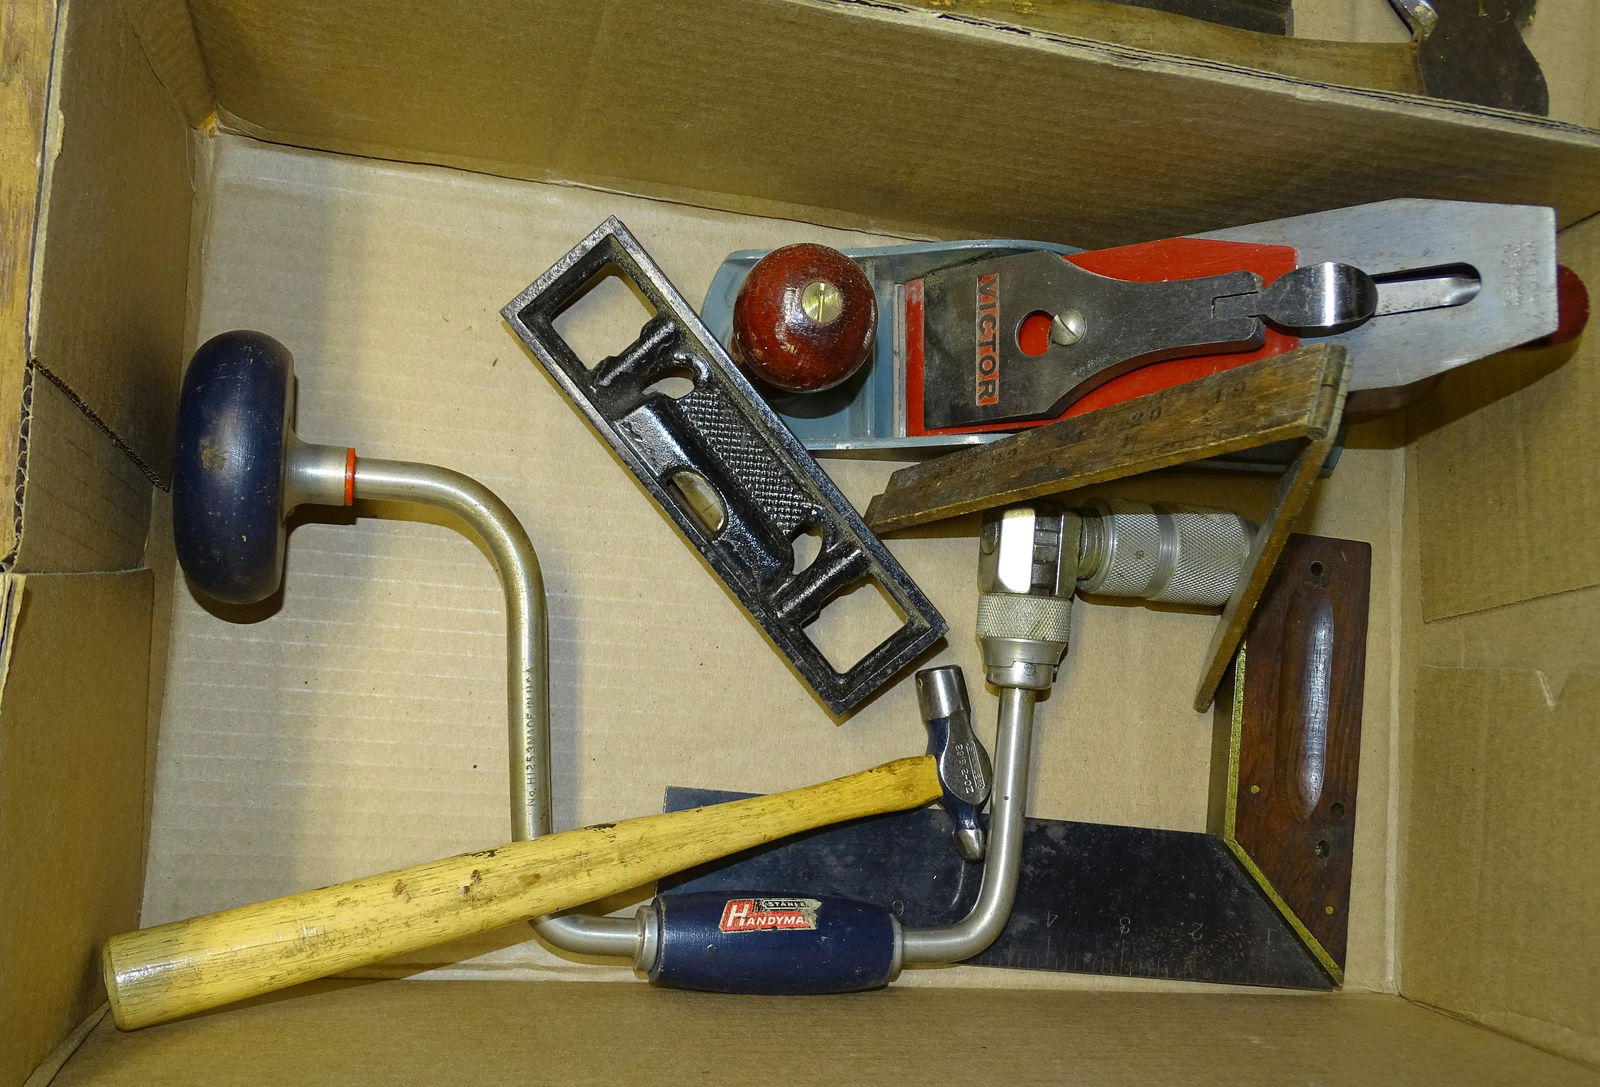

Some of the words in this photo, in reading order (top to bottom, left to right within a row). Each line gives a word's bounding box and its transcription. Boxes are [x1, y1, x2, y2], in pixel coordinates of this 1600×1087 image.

[978, 275, 998, 400] VICTOR
[526, 698, 534, 710] IN
[526, 712, 535, 745] MADE
[726, 904, 804, 927] HANDYMA
[1047, 910, 1058, 928] 4
[1120, 916, 1131, 934] 3
